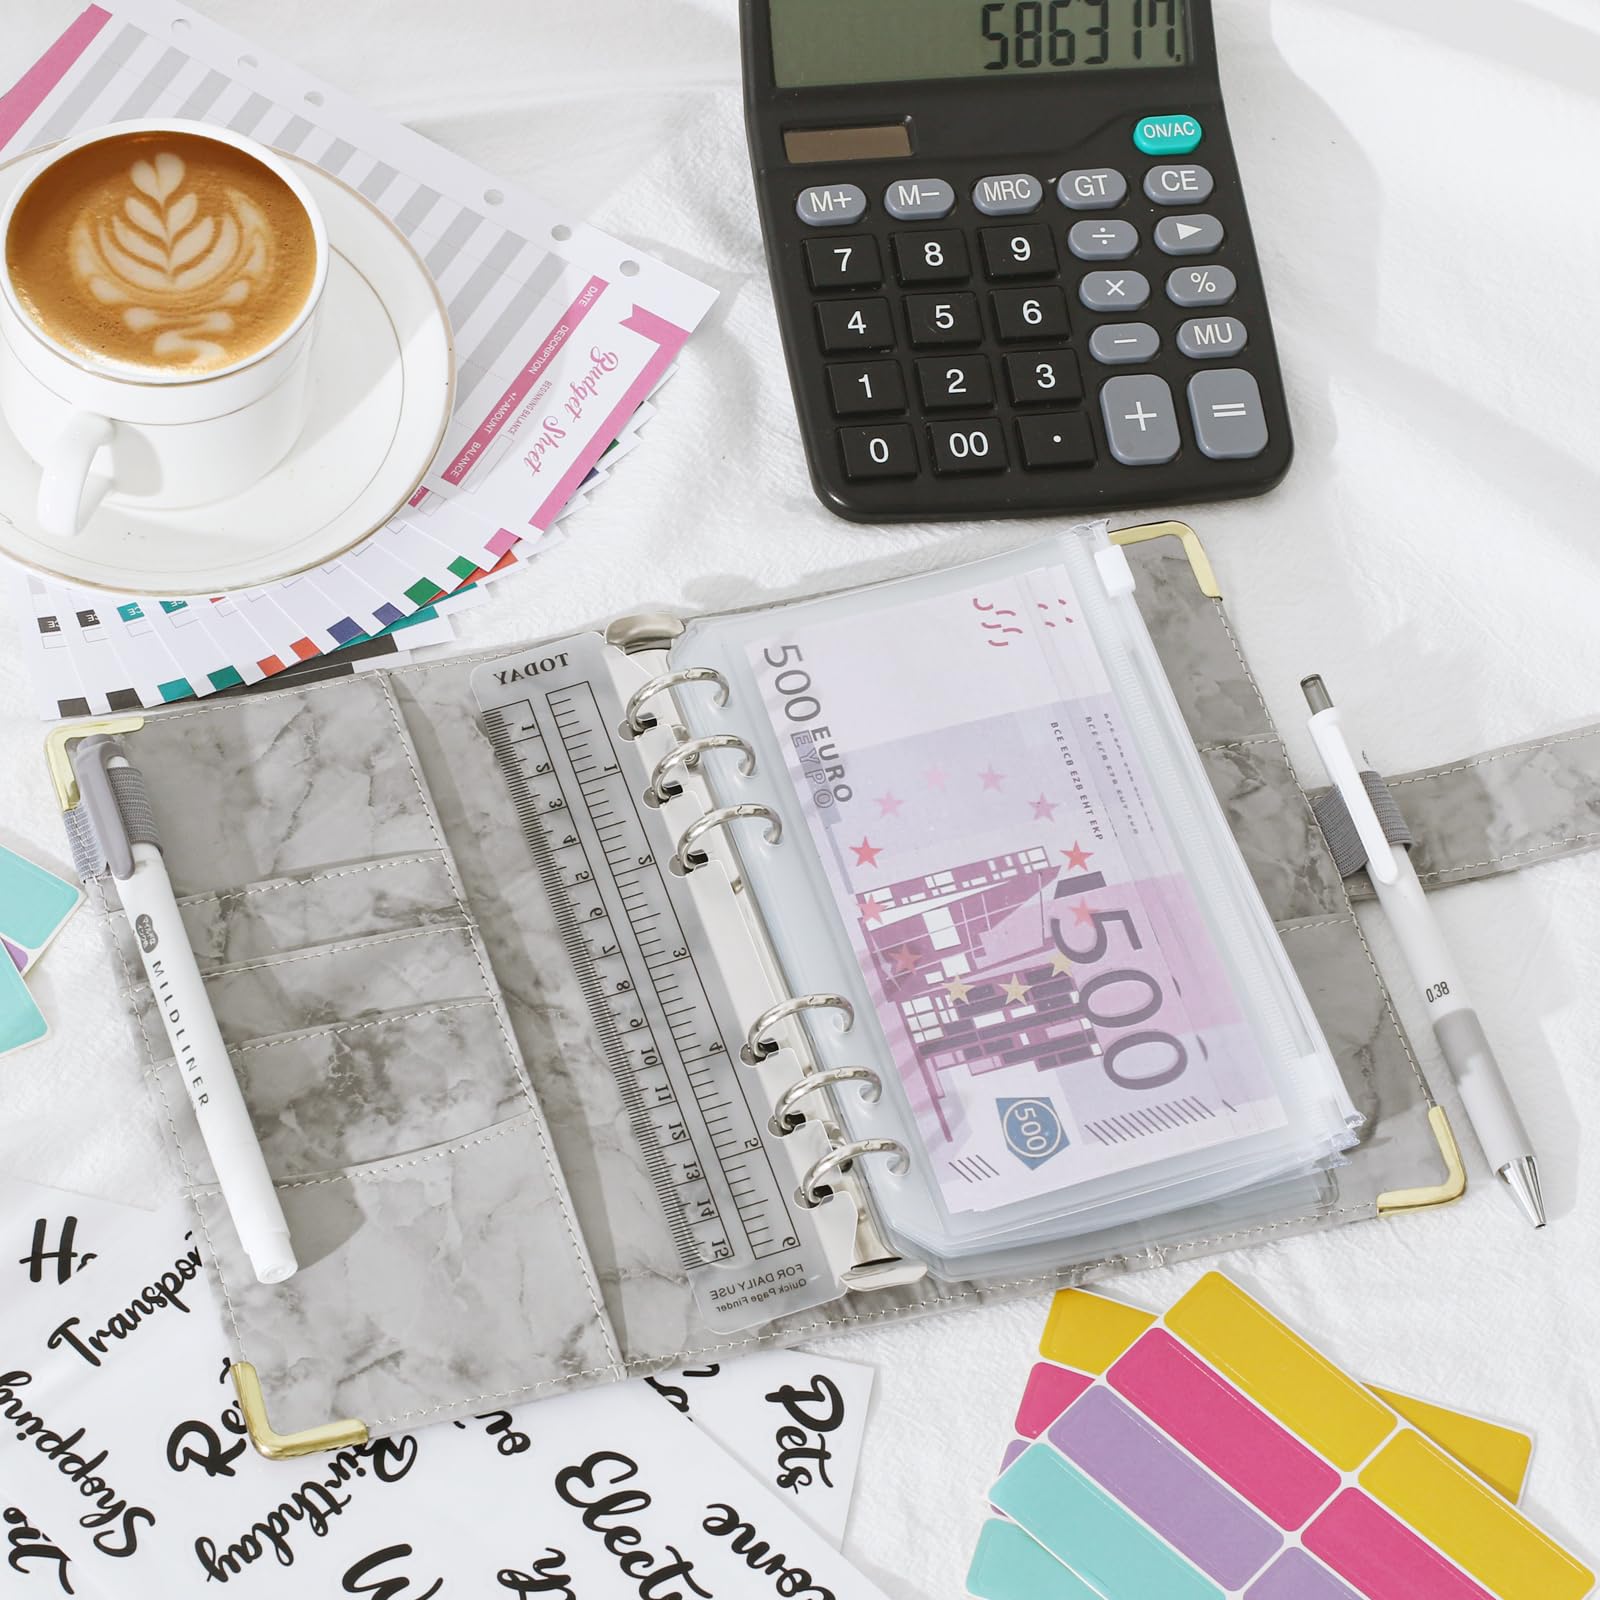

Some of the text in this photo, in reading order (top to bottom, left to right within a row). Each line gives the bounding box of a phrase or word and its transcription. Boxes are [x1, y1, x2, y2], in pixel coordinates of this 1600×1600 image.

[1142, 120, 1196, 139] ON/AC
[983, 178, 1031, 202] MRC
[1073, 173, 1108, 197] GT
[1160, 169, 1199, 192] CE
[810, 191, 853, 213] M+
[833, 247, 853, 272] 7
[923, 241, 944, 267] 8
[1010, 236, 1032, 262] 9
[579, 284, 598, 308] DATE
[847, 310, 867, 335] 4
[934, 305, 955, 329] 5
[1022, 300, 1042, 324] 6
[1193, 323, 1234, 345] MU
[528, 323, 570, 376] DESCRIPTION
[859, 374, 873, 399] 1
[946, 368, 967, 394] 2
[1035, 364, 1056, 389] 3
[507, 408, 531, 435] BALANCE
[523, 345, 619, 477] Budget Sheet
[869, 437, 890, 463] 0
[949, 431, 989, 459] 00
[450, 441, 482, 479] BALANCE
[763, 644, 854, 803] 500 EURO
[1050, 721, 1104, 841] BCE ECB EZB EHT EKP
[1050, 909, 1188, 1091] 500
[1425, 980, 1450, 1003] 0.38
[151, 960, 209, 1107] MILDLINER
[1014, 1107, 1047, 1152] 500
[764, 1374, 845, 1494] Pets
[195, 1435, 418, 1583] Birthday
